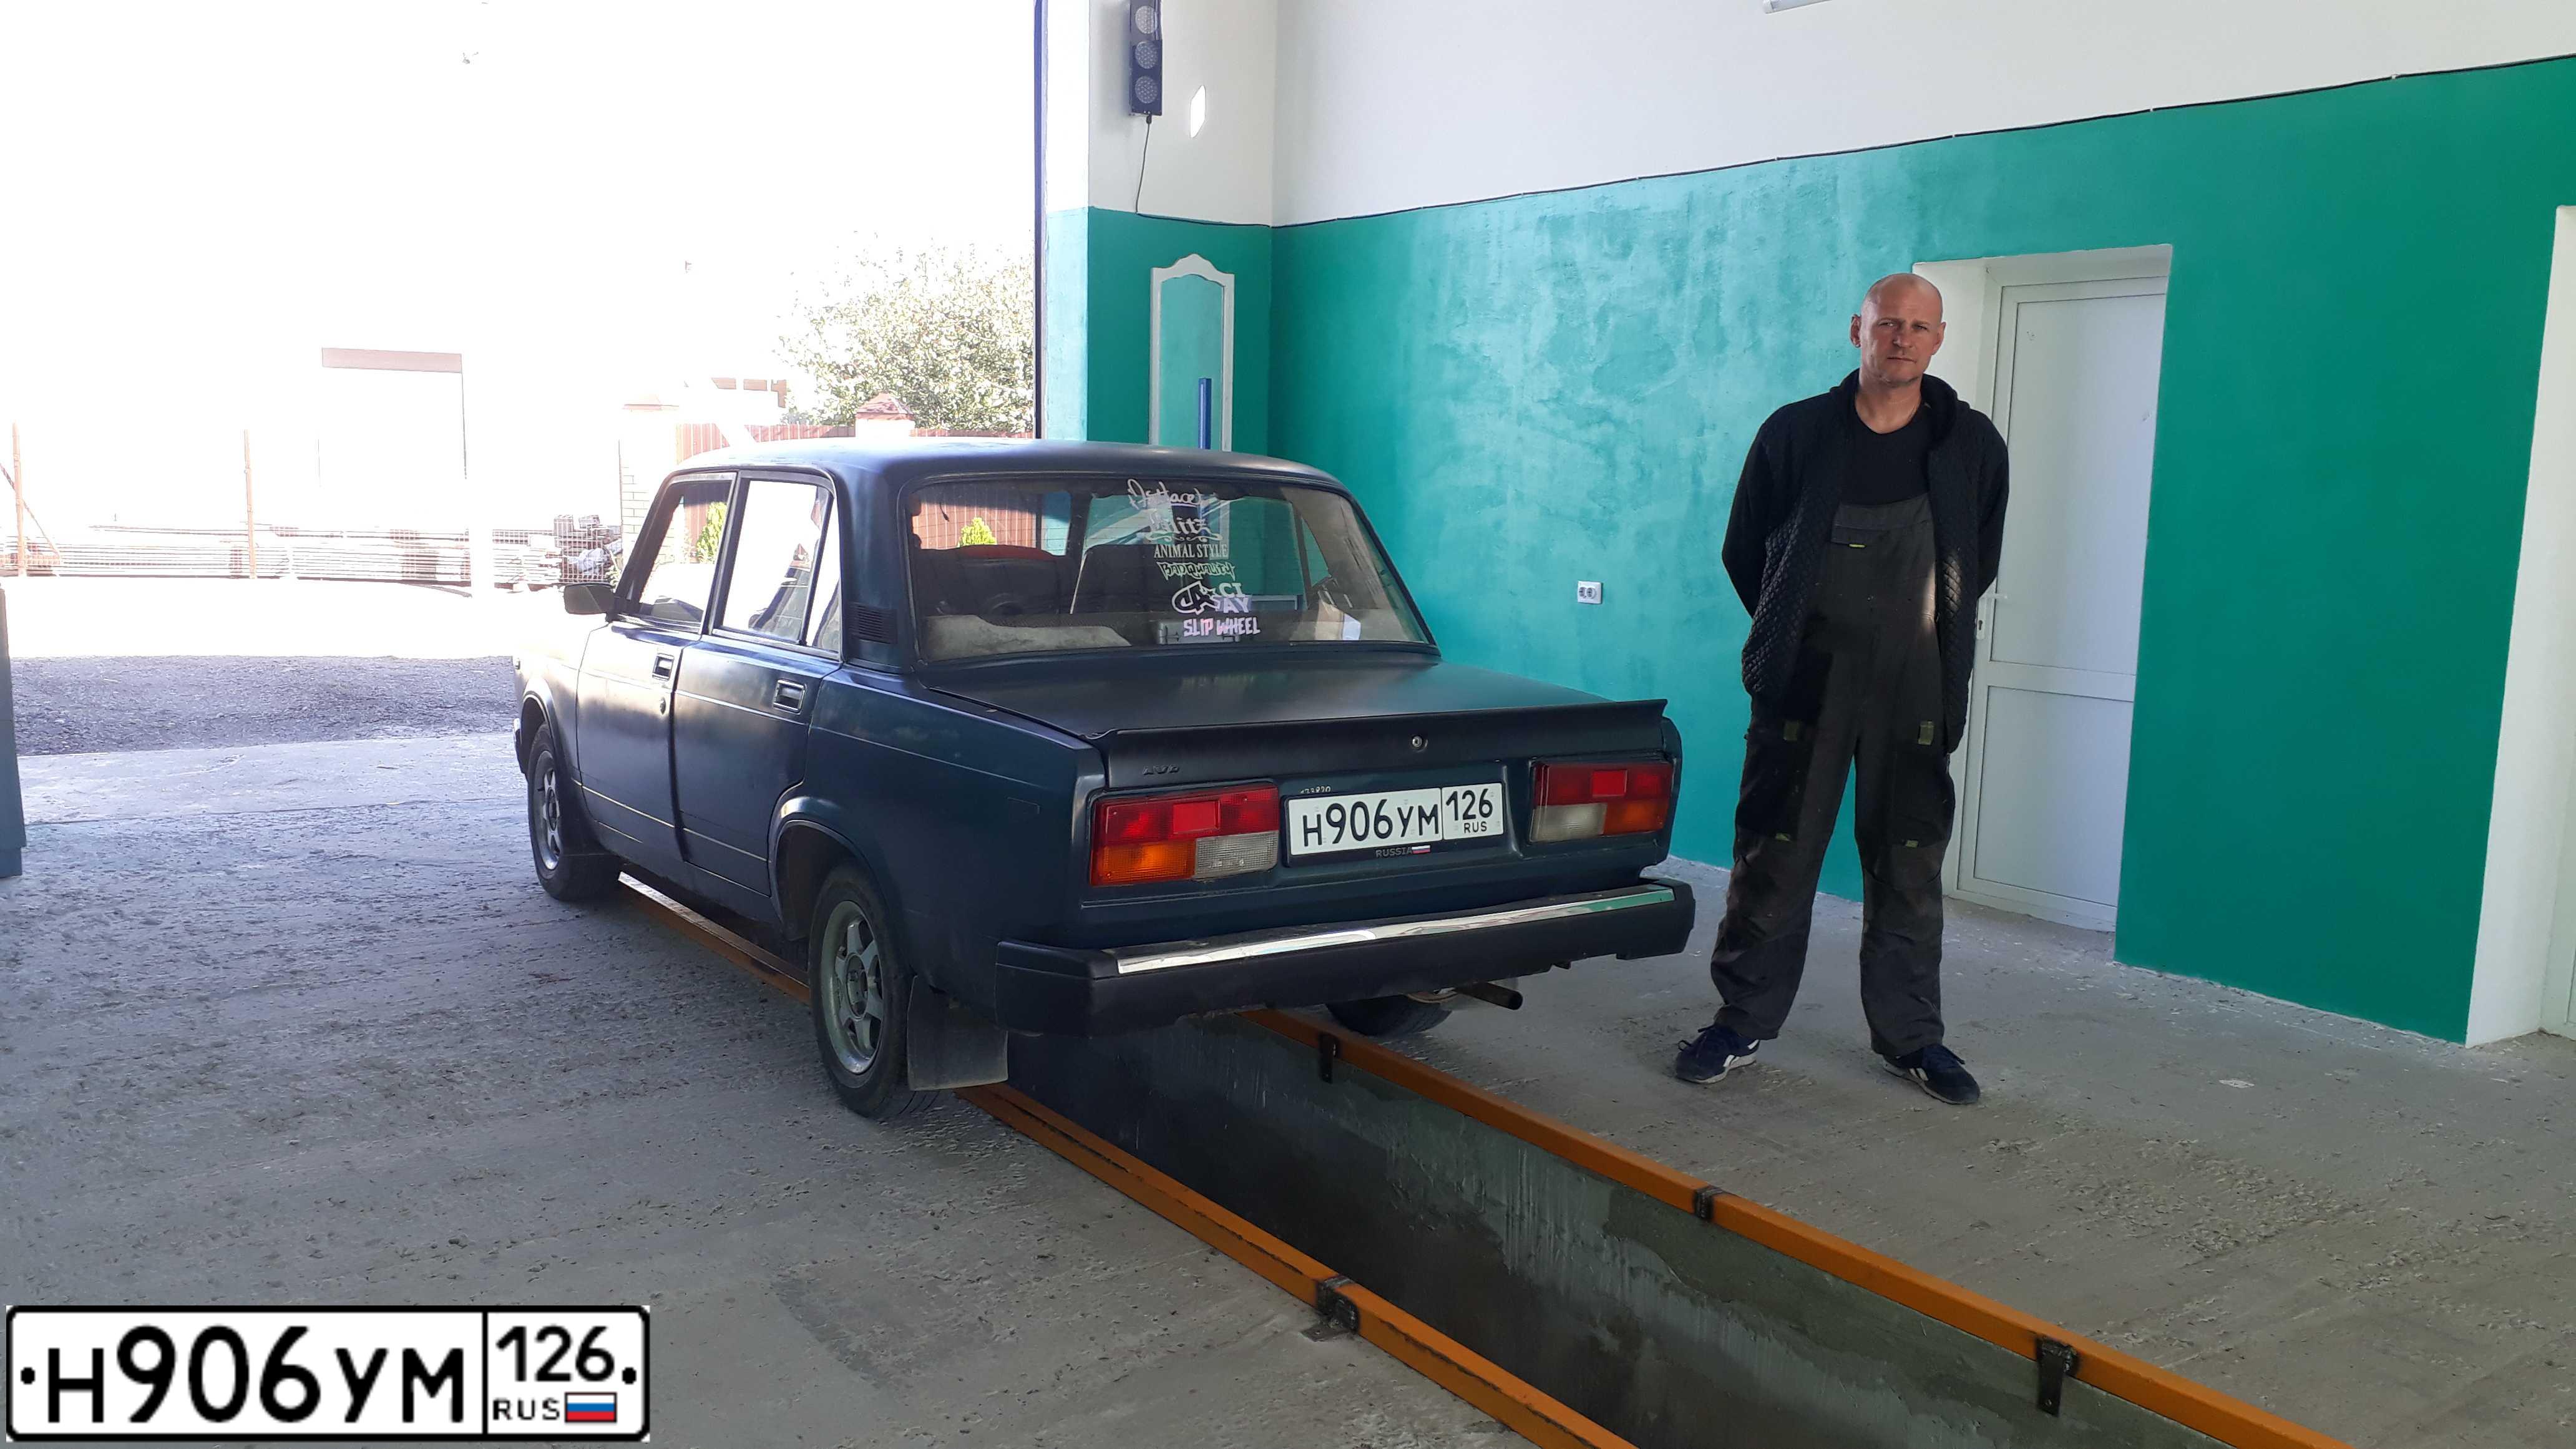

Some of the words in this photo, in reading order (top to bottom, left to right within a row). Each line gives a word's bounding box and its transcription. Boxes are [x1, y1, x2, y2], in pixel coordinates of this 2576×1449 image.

[1154, 544, 1195, 559] ANIMAL
[1197, 544, 1228, 559] STYLE
[1183, 618, 1213, 637] SLIP
[1216, 617, 1261, 637] WHEEL
[1445, 789, 1493, 821] 126
[1463, 822, 1488, 834] RUS
[1375, 846, 1413, 858] RUSSIA
